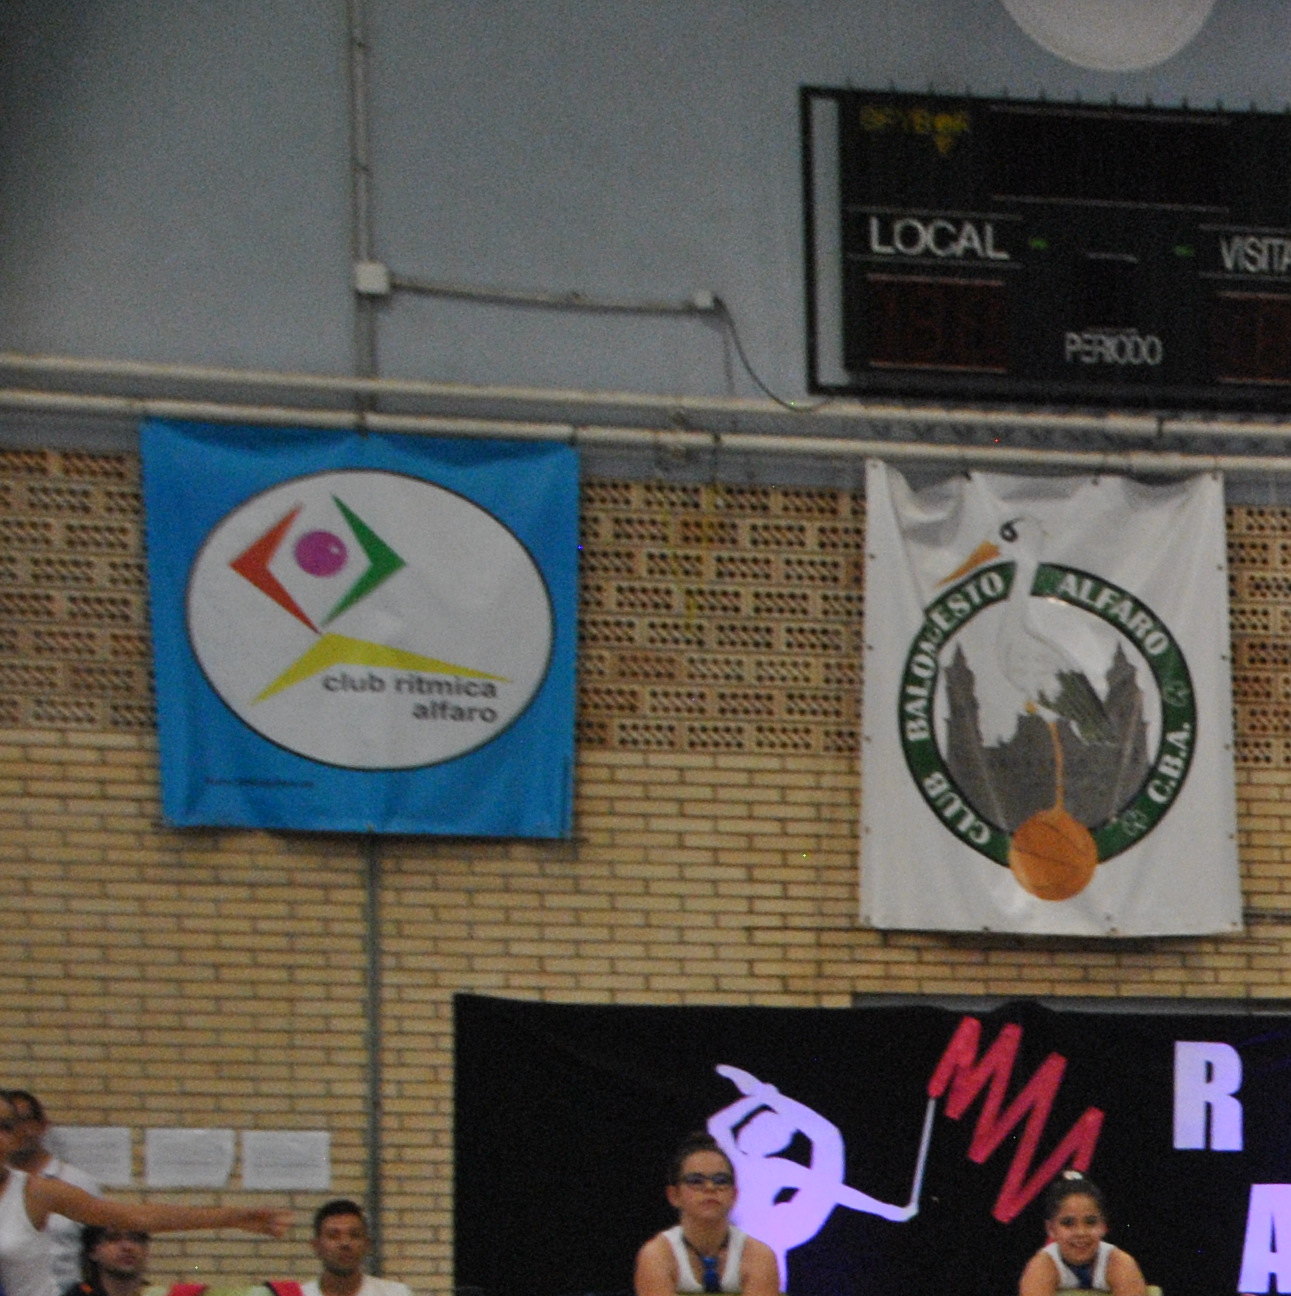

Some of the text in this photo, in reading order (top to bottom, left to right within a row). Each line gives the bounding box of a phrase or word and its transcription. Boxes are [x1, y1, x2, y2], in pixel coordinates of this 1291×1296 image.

[869, 217, 1010, 261] LOCAL
[1065, 331, 1163, 365] PERIODO
[1057, 574, 1169, 657] ALFARO
[322, 671, 385, 692] club
[412, 701, 498, 723] alfaro
[921, 770, 992, 847] CLUB
